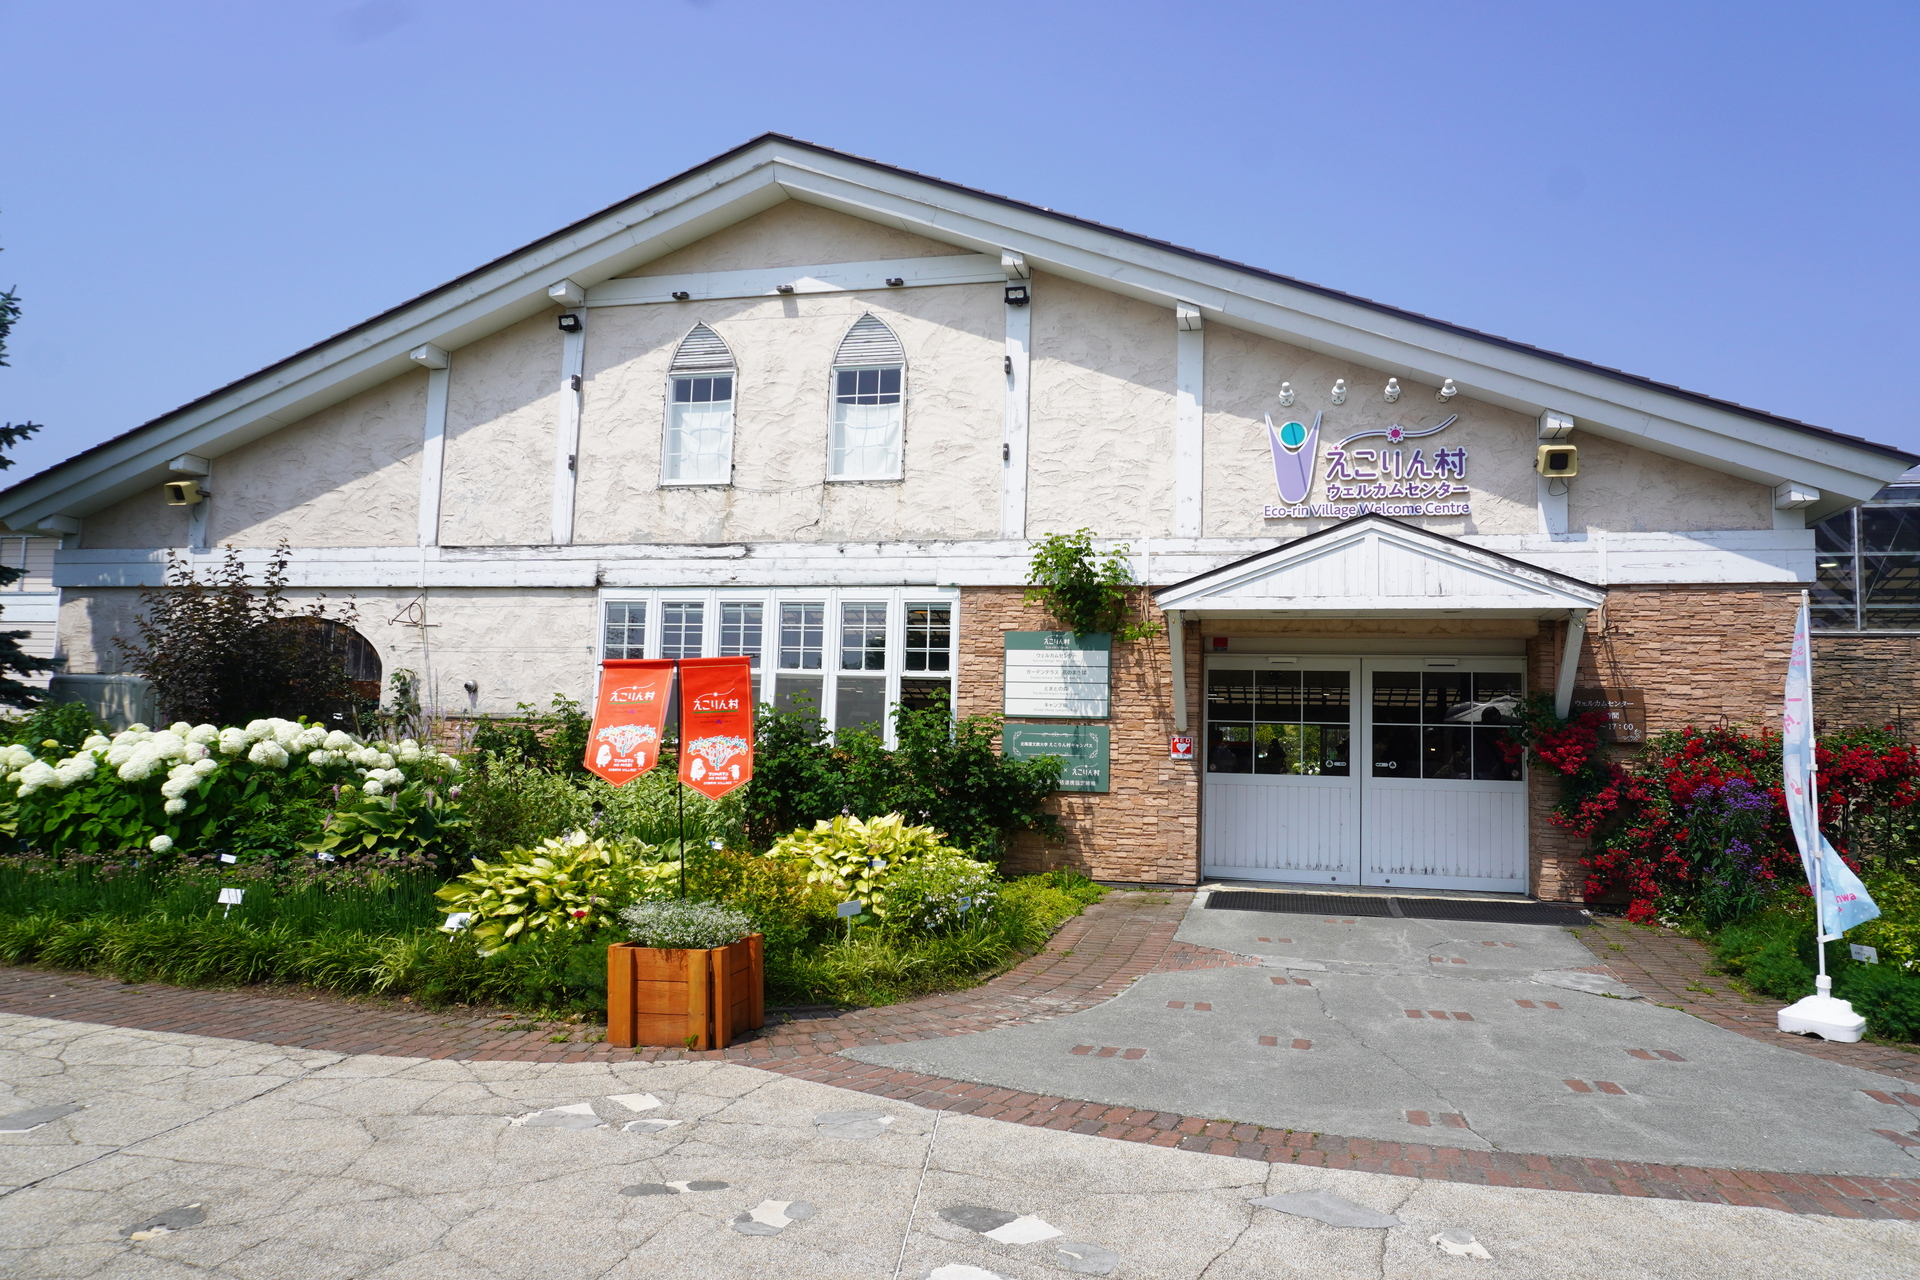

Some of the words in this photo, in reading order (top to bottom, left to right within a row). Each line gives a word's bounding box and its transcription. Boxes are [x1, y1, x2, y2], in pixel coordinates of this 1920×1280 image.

[1326, 447, 1466, 479] えこりん村
[1326, 482, 1468, 498] ウェルカムセンター
[1264, 504, 1309, 517] Eco-rin
[1311, 503, 1356, 518] Village
[1358, 502, 1422, 515] Welcome
[1425, 502, 1469, 514] Centre
[609, 690, 656, 702] えこりん村
[693, 698, 739, 710] えこりん村
[1071, 768, 1100, 776] えこりん村
